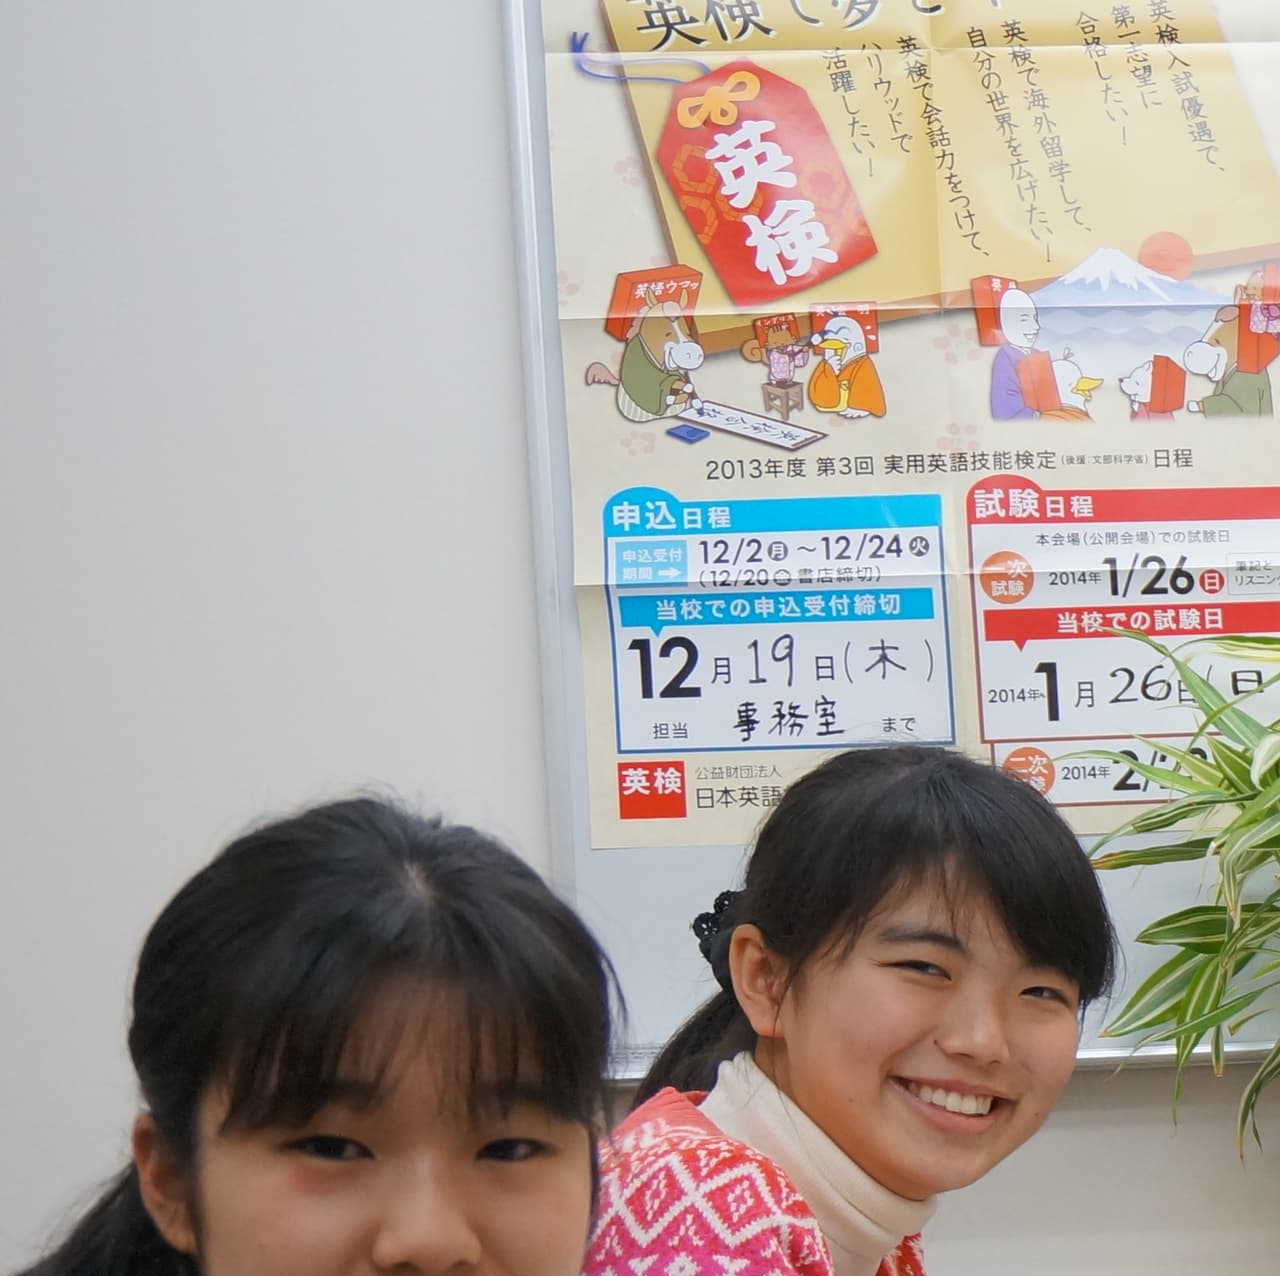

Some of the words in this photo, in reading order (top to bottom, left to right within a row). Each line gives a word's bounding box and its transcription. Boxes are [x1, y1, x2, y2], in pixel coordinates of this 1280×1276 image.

[1111, 5, 1163, 109] 第一志望に
[861, 41, 914, 153] ハリウッドで
[705, 120, 839, 287] 英検
[705, 457, 807, 481] 2013年度
[815, 455, 875, 478] 第3回
[883, 450, 1057, 475] 実用英語技能検定
[1153, 448, 1194, 470] 日程
[611, 500, 732, 531] 申込日程
[973, 488, 1095, 521] 試験日程
[1035, 529, 1232, 547] 本会場(公開会場)での試験日
[622, 548, 682, 565] 申込受付
[985, 559, 1029, 580] 一次
[622, 567, 653, 582] 期間
[990, 580, 1026, 598] 試験
[655, 594, 901, 622] 当校での申込受付締切
[1057, 608, 1224, 635] 当校での試験日
[651, 721, 689, 740] 担当
[732, 695, 846, 743] 事務室
[881, 717, 918, 733] まで
[1009, 754, 1049, 775] 二次
[621, 767, 683, 796] 英検
[695, 764, 783, 781] 公益財団法人
